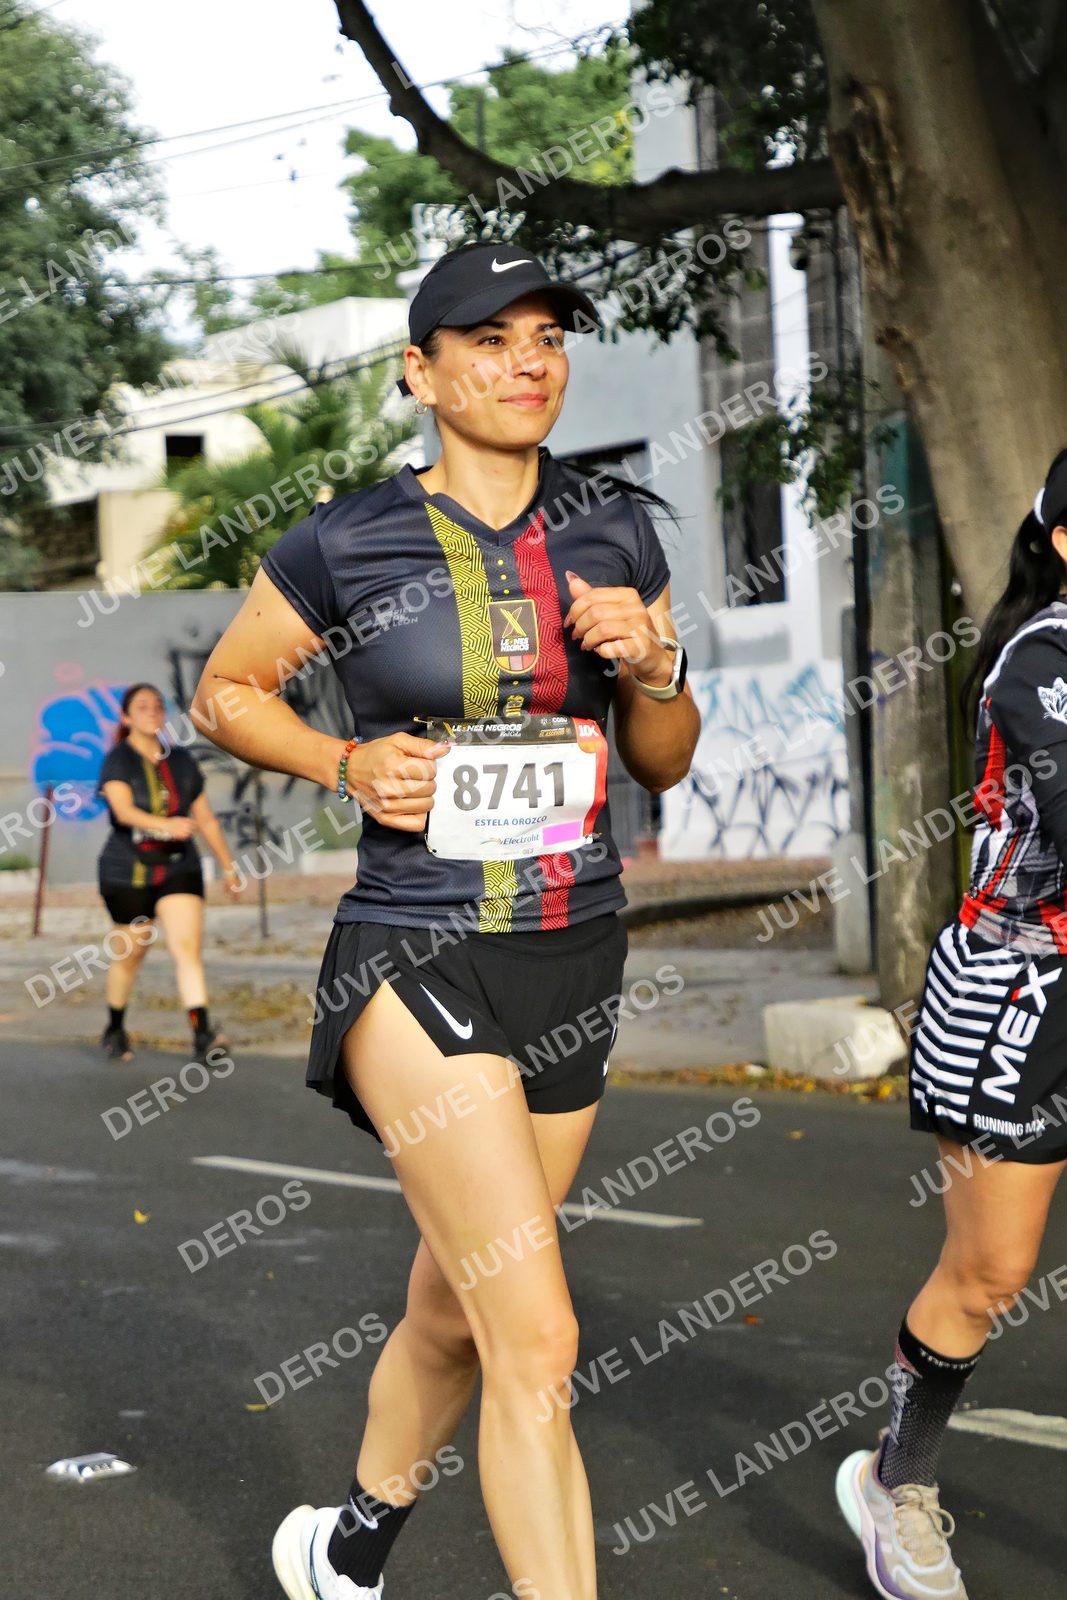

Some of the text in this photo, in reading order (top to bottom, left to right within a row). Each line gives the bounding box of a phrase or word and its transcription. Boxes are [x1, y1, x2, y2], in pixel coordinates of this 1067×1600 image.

[485, 723, 522, 731] NEGROS
[578, 724, 599, 737] 10K
[452, 761, 564, 811] 8741
[475, 815, 548, 827] ESTELA OROZCO
[981, 962, 1062, 1104] MEX
[973, 1113, 1046, 1136] RUNNING MX
